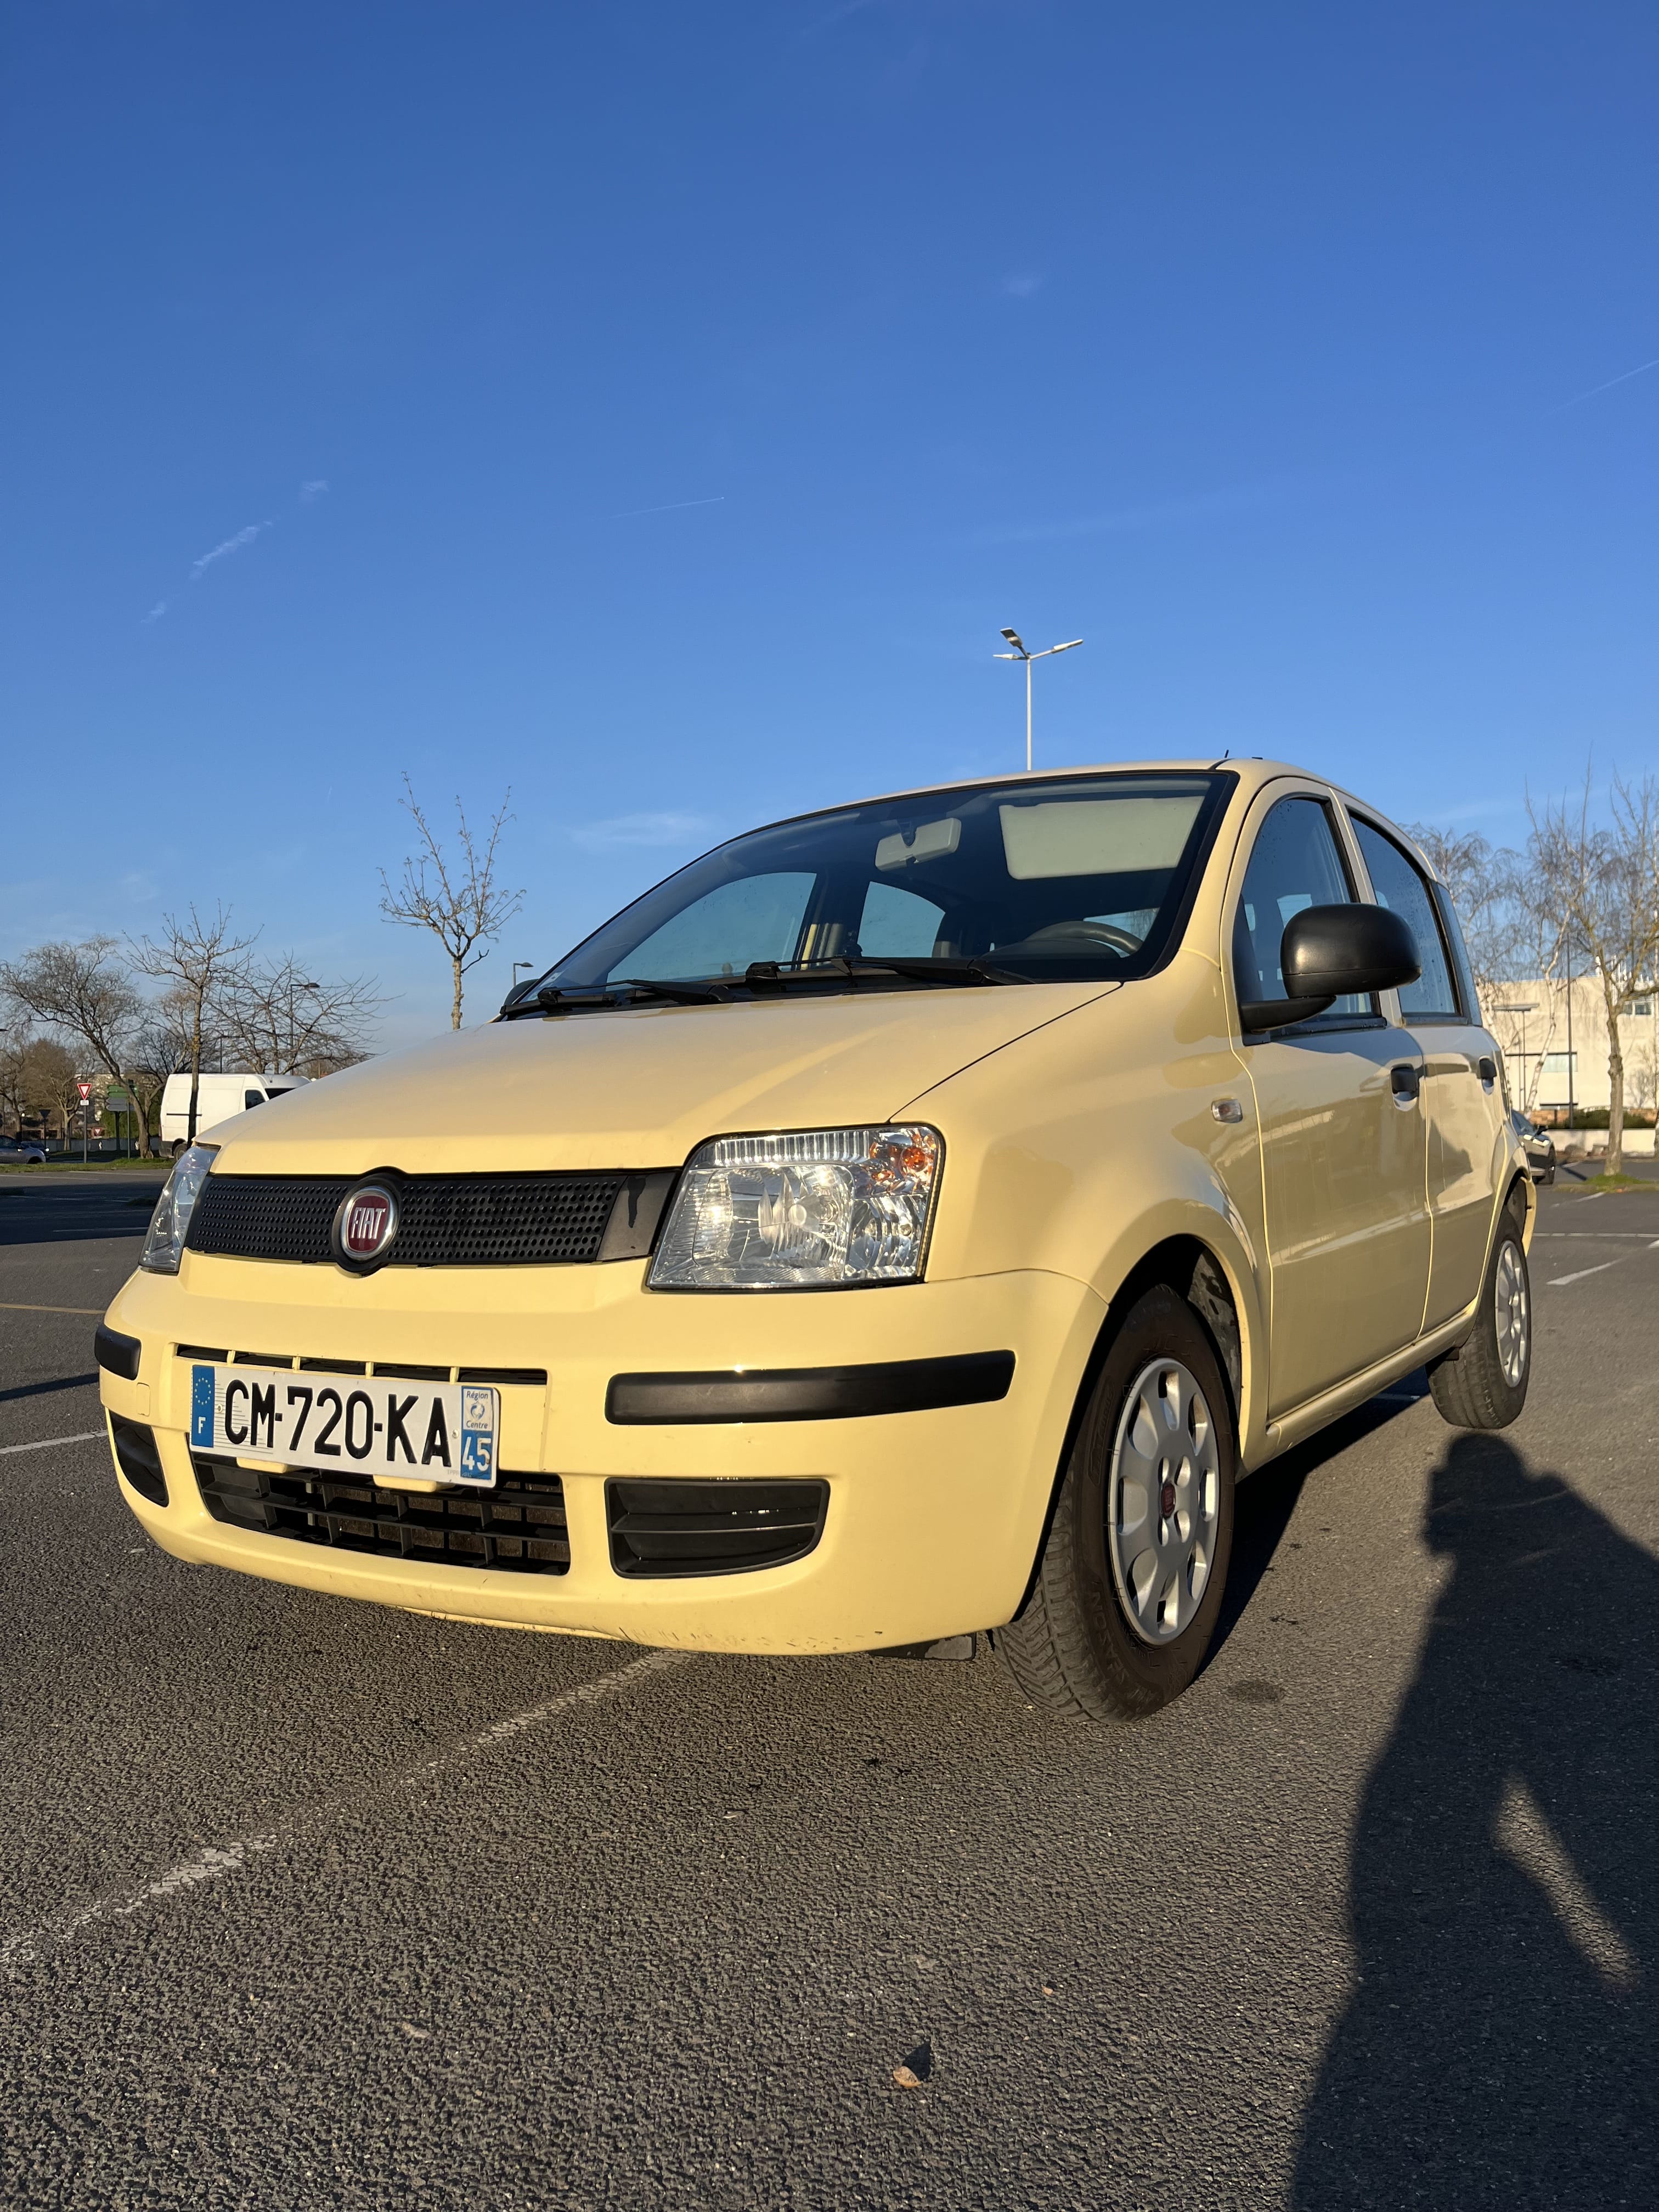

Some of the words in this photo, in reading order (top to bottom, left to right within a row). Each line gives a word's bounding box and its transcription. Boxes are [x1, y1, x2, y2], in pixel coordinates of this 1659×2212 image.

[350, 1207, 386, 1239] FIAT
[466, 1391, 488, 1401] Région
[198, 1417, 206, 1434] F
[225, 1379, 452, 1467] CM-720-KA
[466, 1420, 488, 1429] Centre
[462, 1436, 492, 1471] 45
